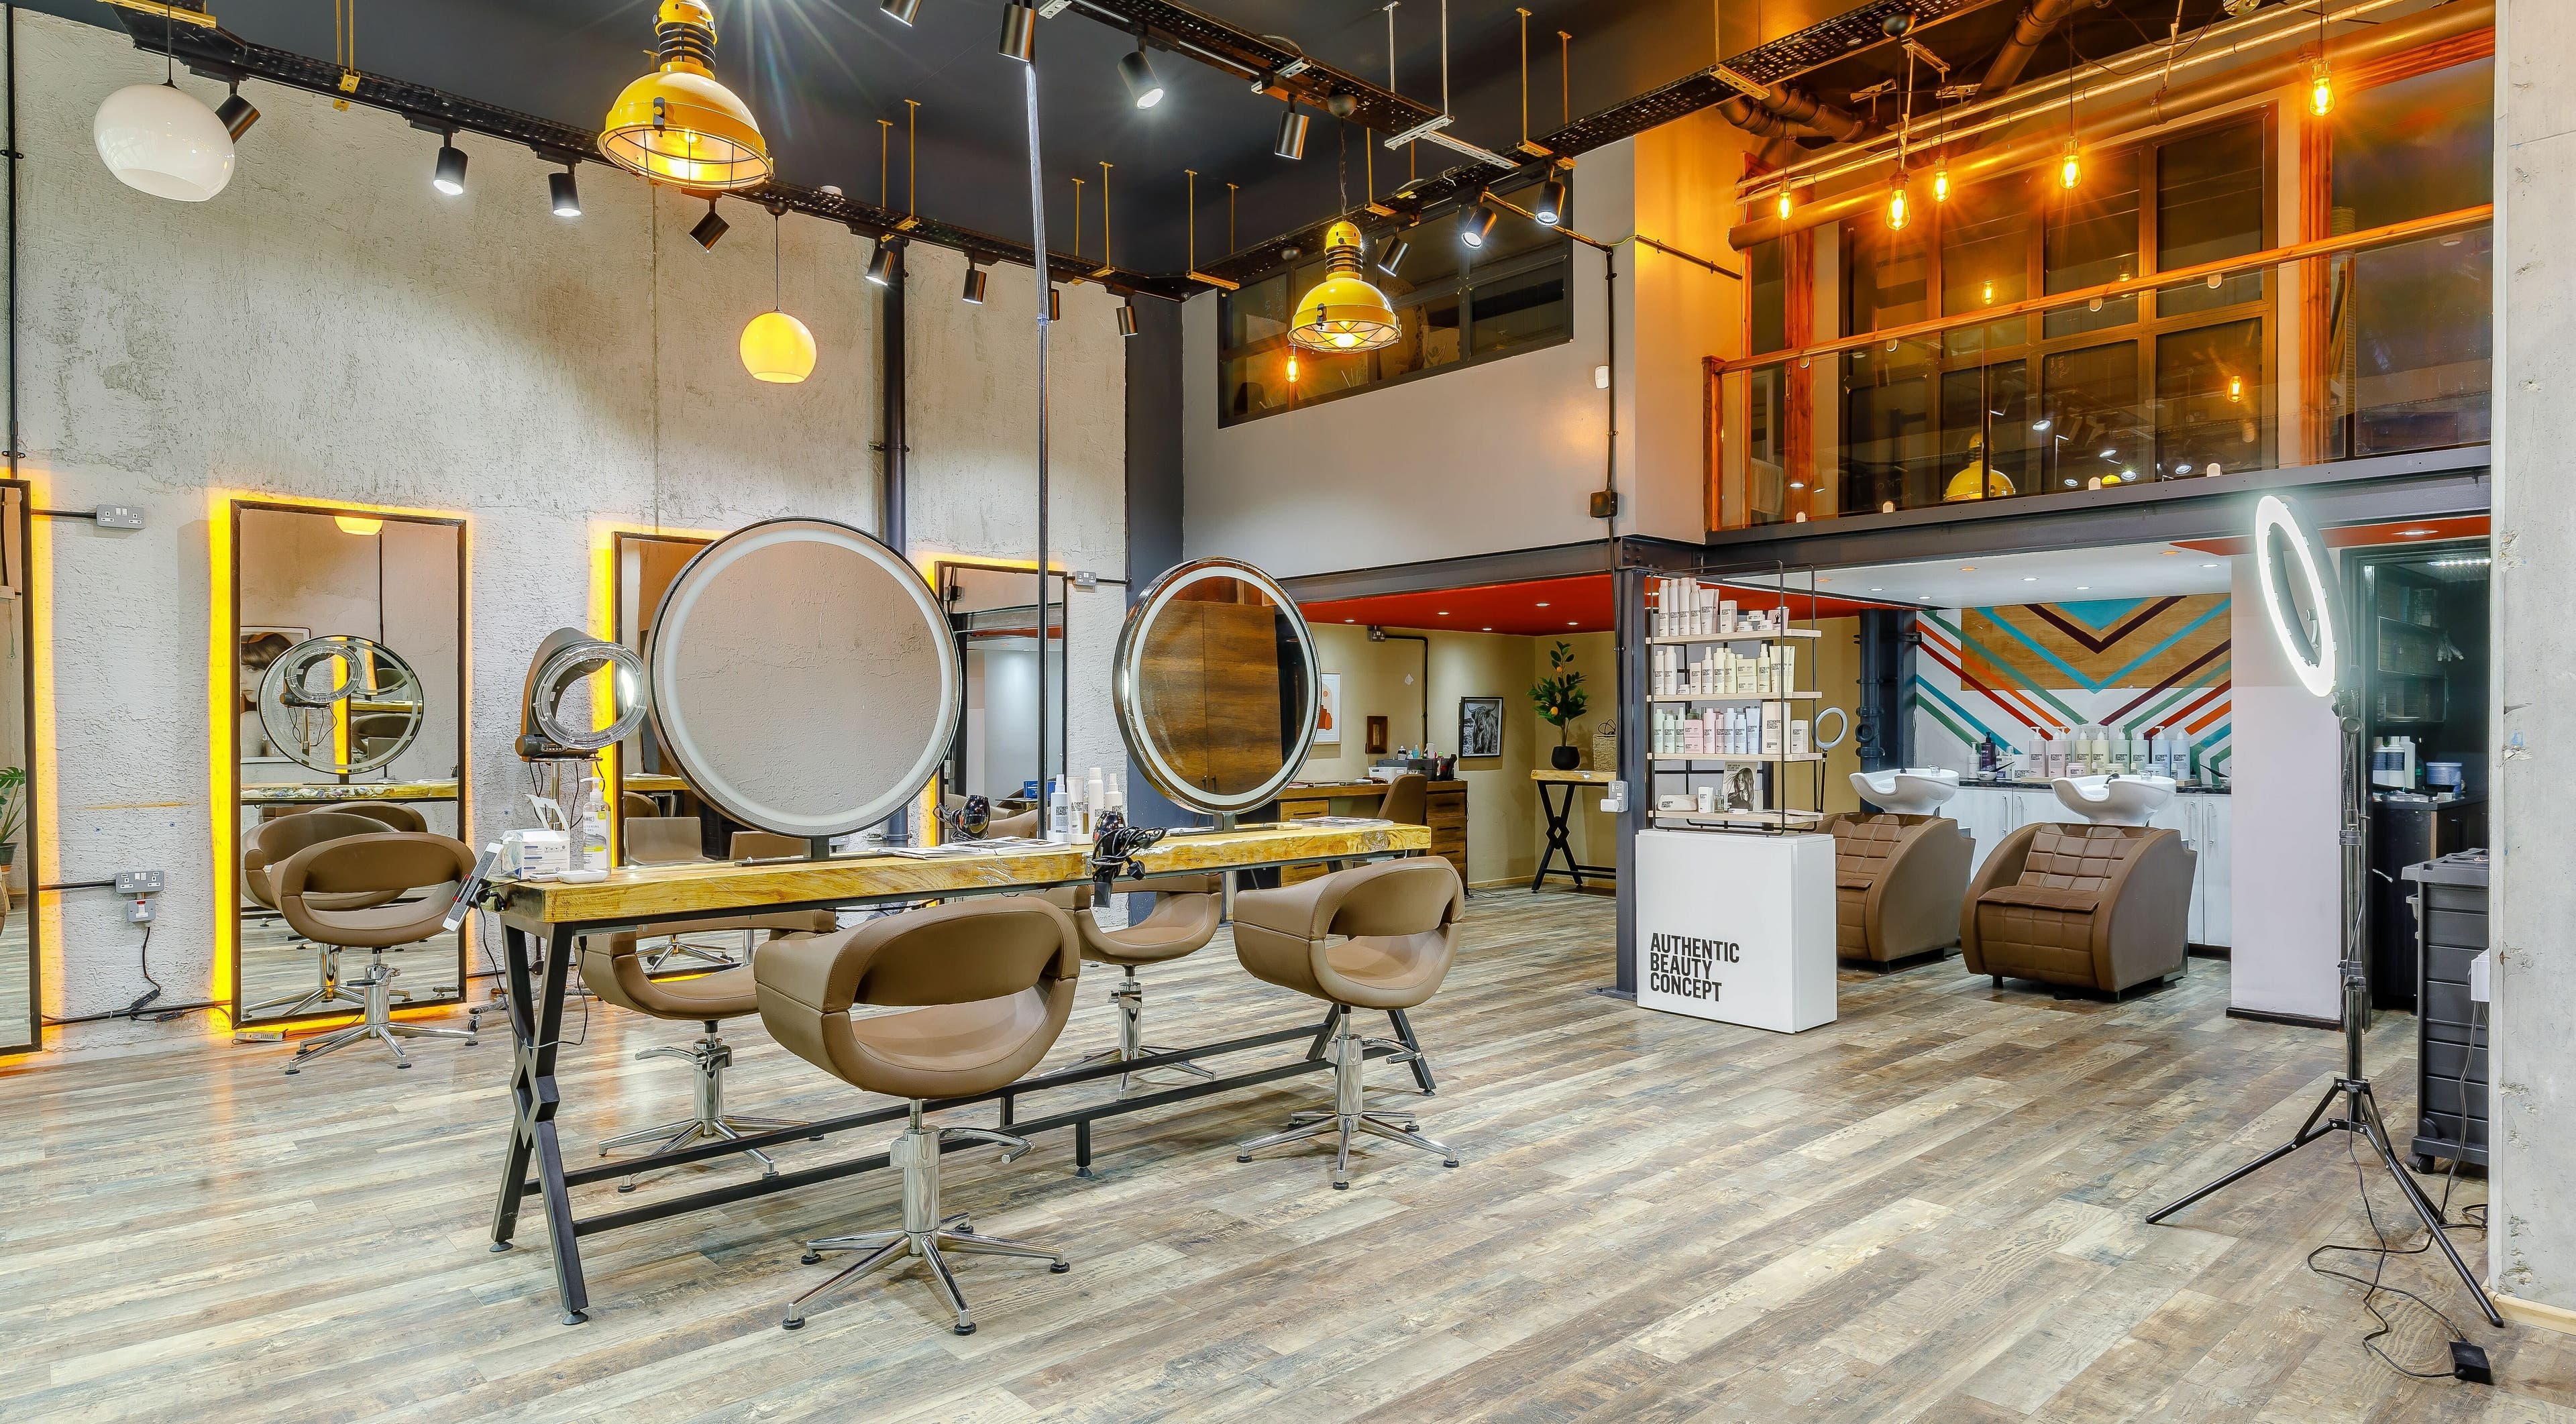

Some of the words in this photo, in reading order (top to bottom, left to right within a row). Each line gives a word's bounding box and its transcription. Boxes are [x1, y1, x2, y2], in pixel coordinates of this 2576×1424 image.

[1650, 932, 1739, 963] AUTHENTIC
[1650, 952, 1713, 980] BEAUTY
[1650, 972, 1722, 1002] CONCEPT
